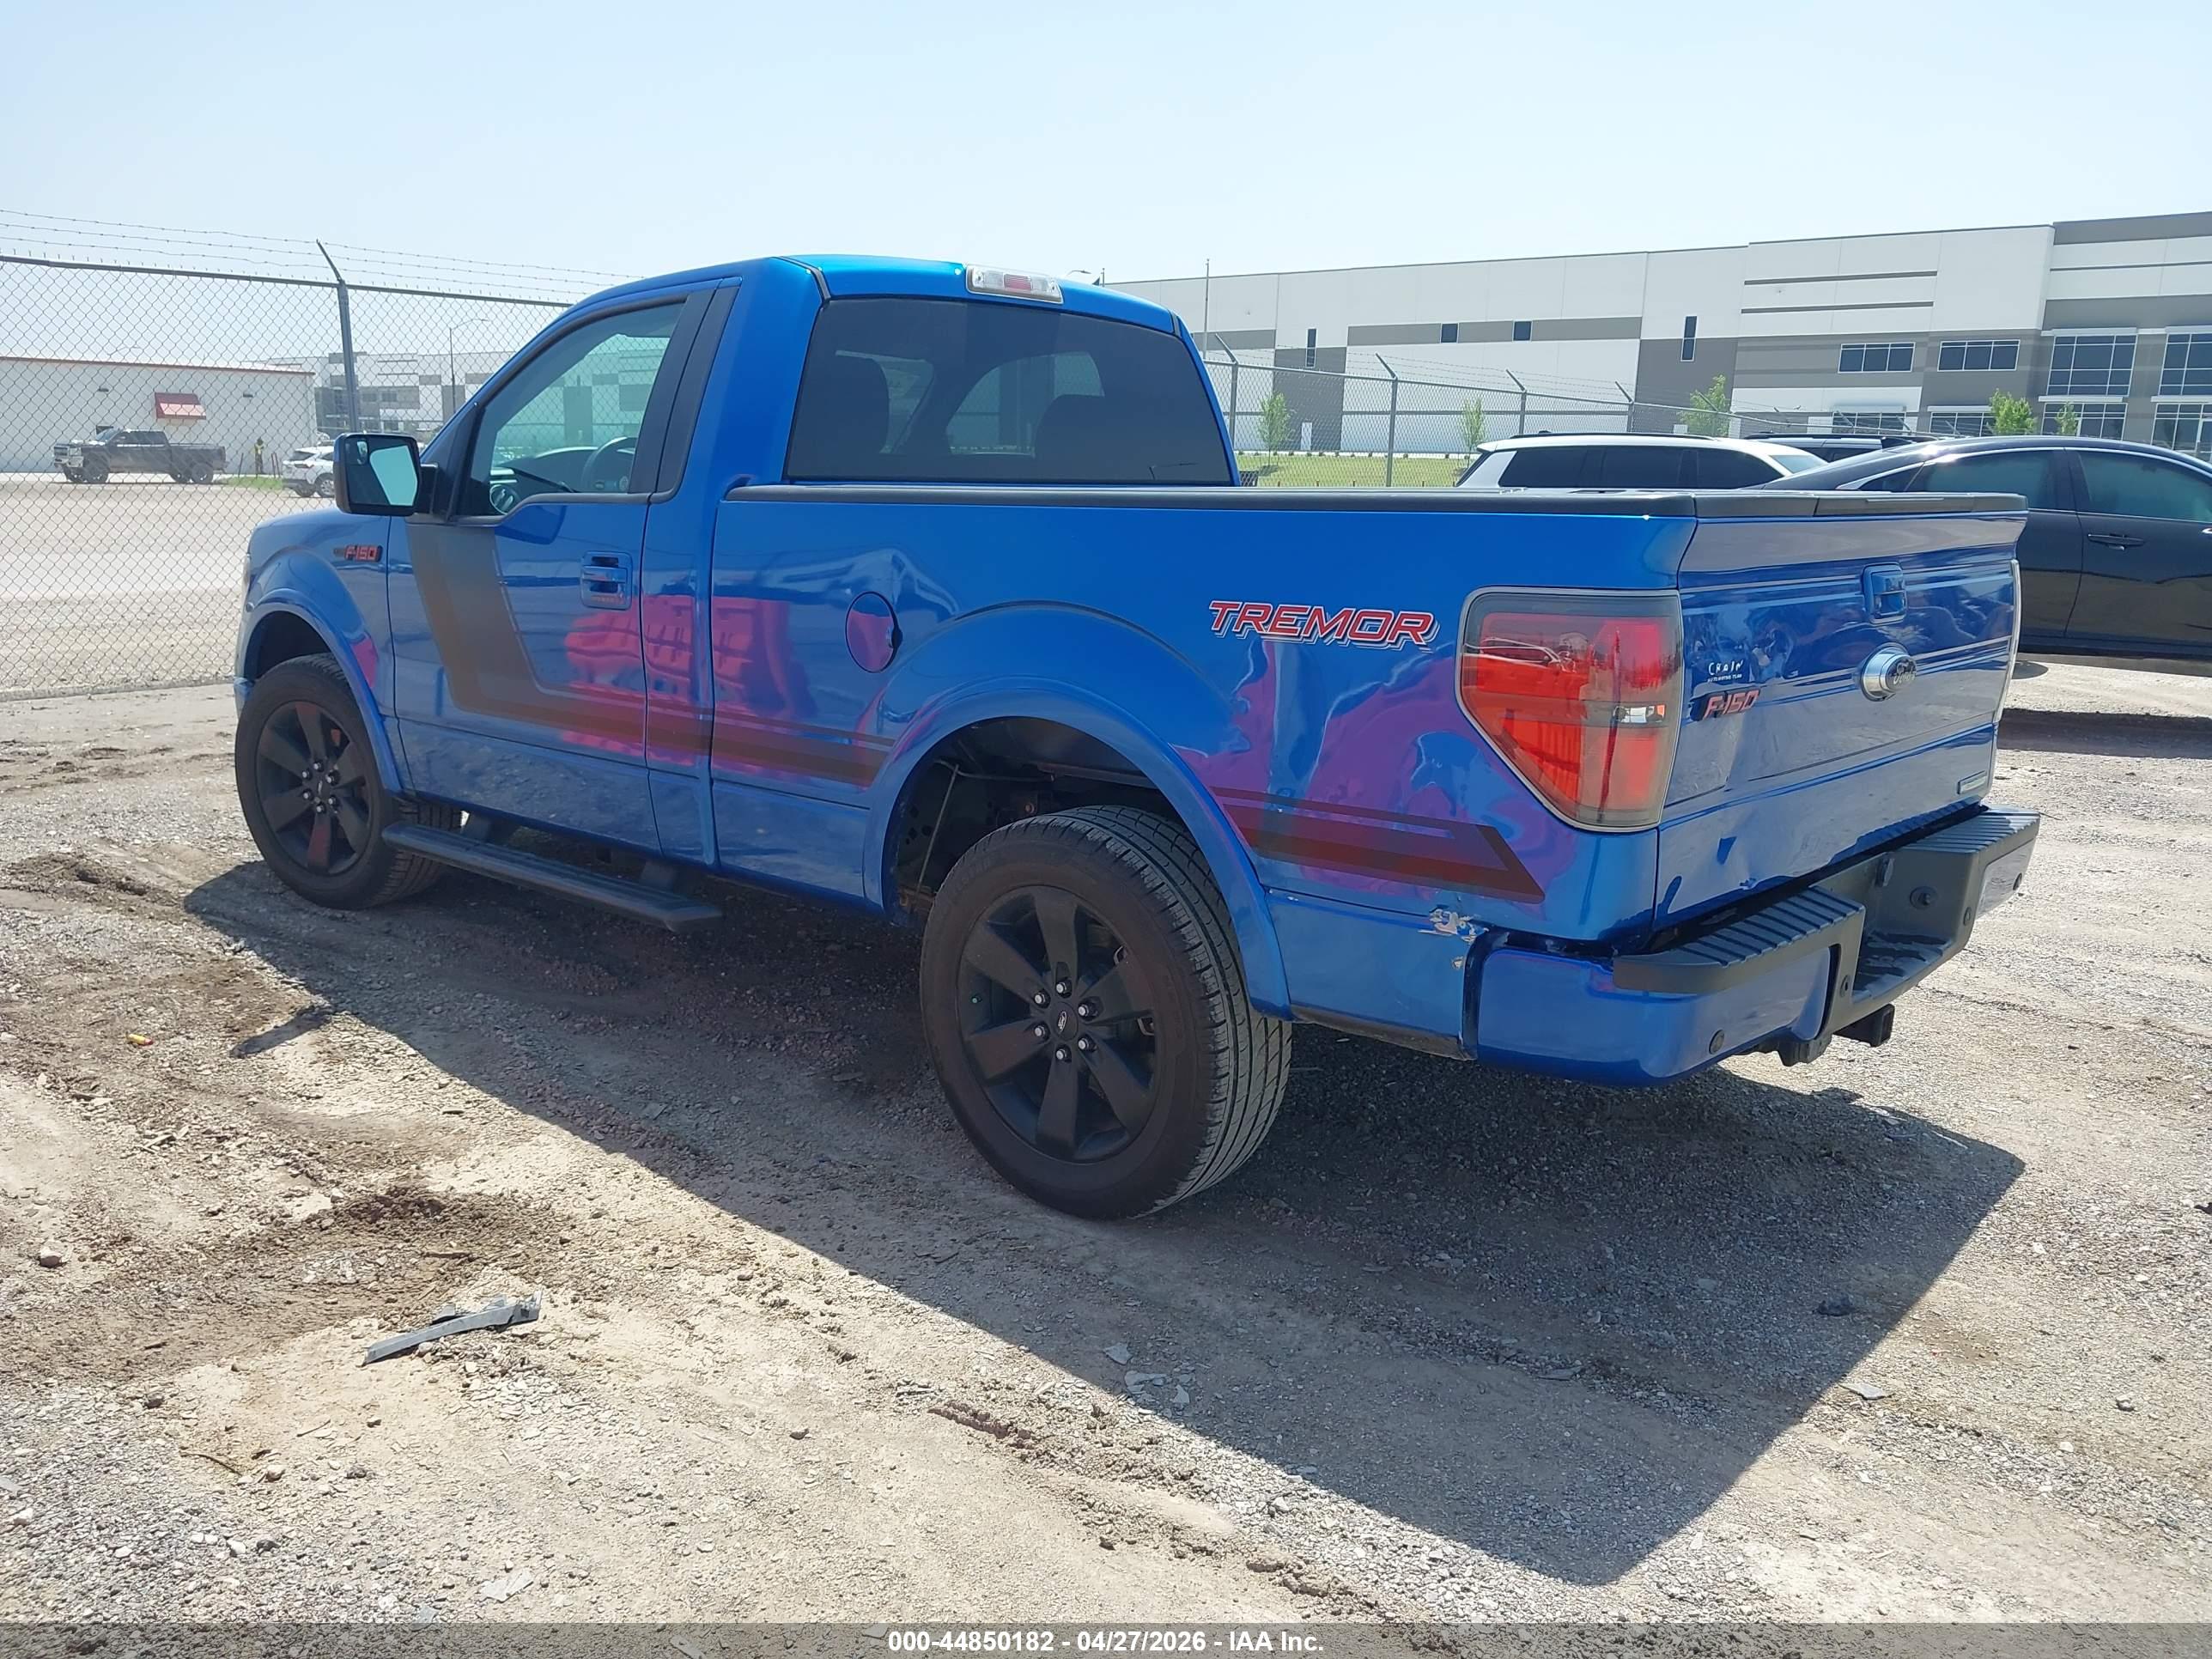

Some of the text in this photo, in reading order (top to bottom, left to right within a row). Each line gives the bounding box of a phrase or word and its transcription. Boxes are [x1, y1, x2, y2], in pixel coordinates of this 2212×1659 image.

[345, 545, 377, 562] F-150
[1209, 600, 1438, 650] TREMOR
[1703, 690, 1759, 719] F-150
